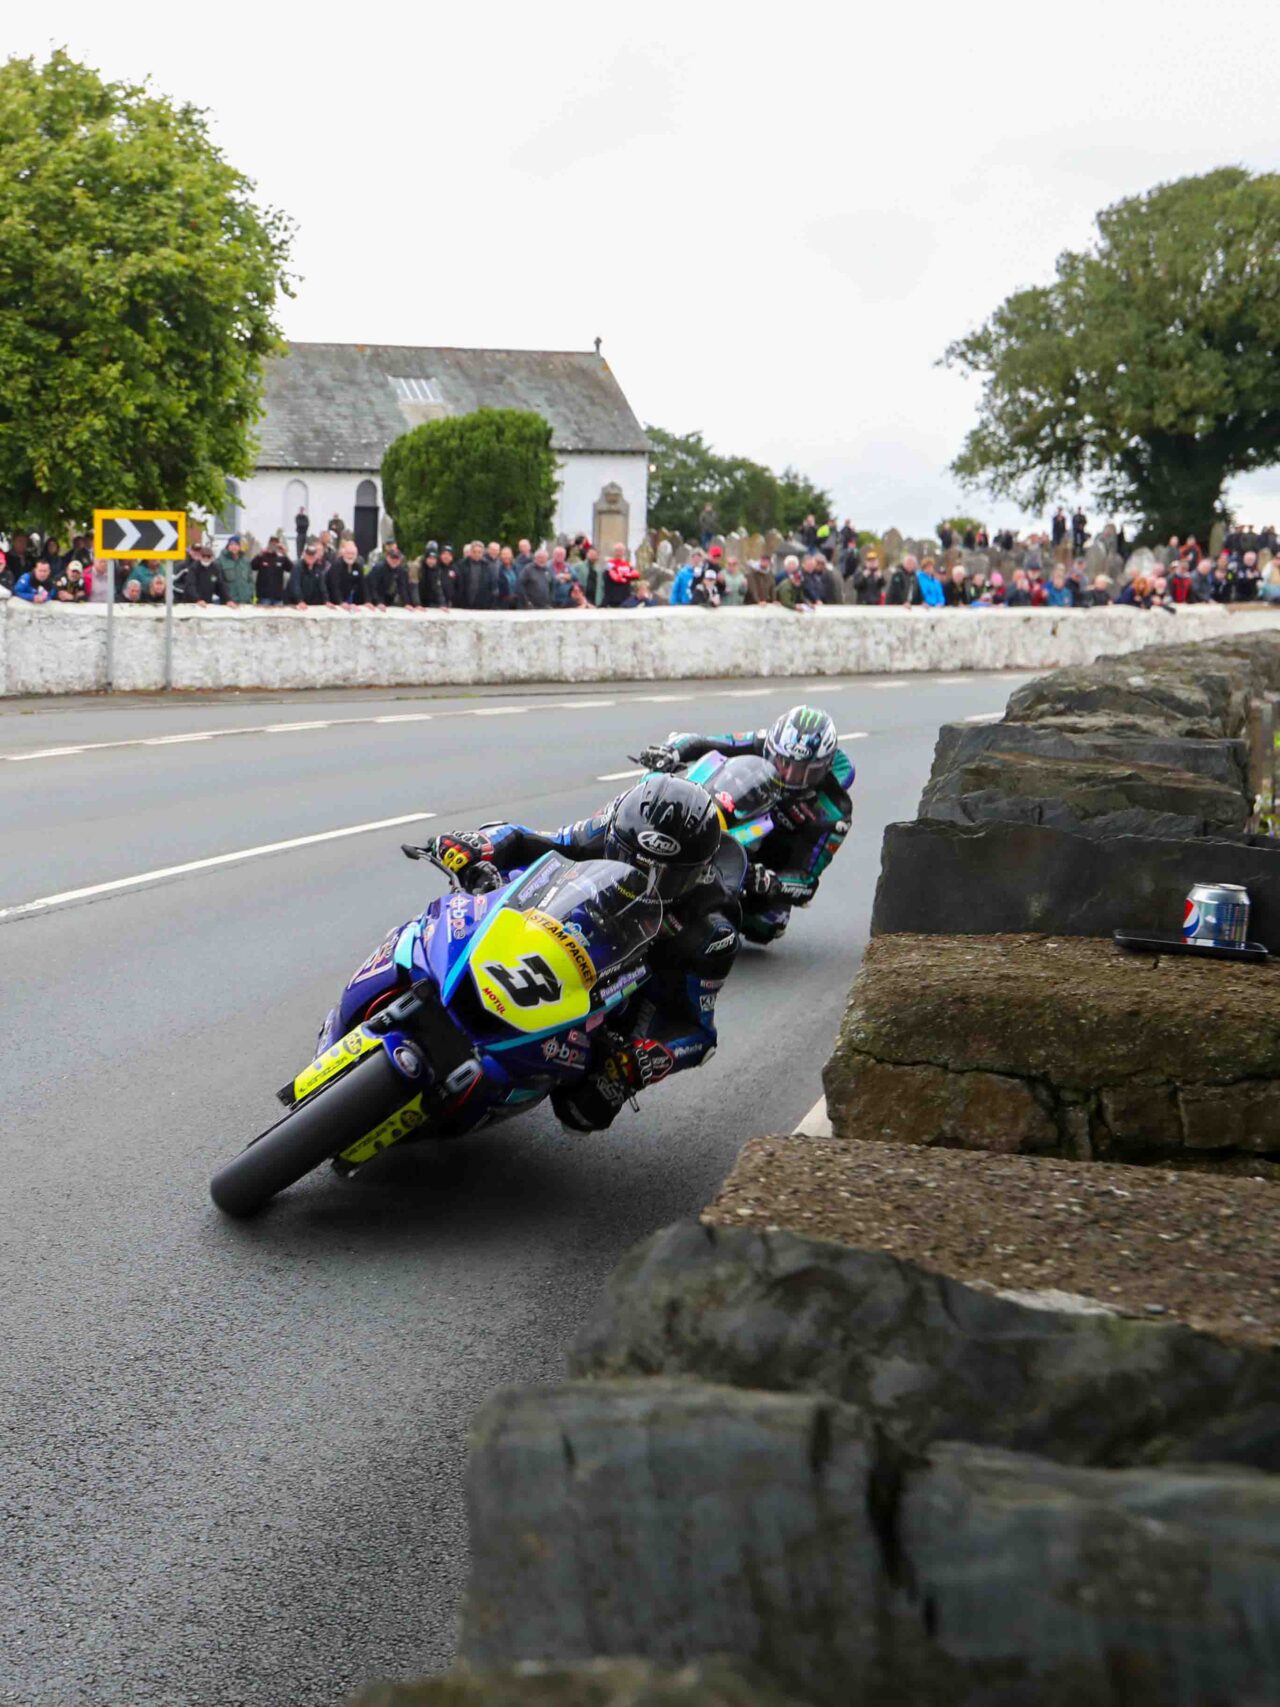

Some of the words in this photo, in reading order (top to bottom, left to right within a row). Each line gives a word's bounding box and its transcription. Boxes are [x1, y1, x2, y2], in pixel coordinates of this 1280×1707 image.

[641, 833, 677, 851] Arai
[531, 914, 569, 941] STEAM
[565, 938, 595, 984] PACKET
[482, 987, 507, 1016] MOTUL
[483, 954, 562, 1008] 3
